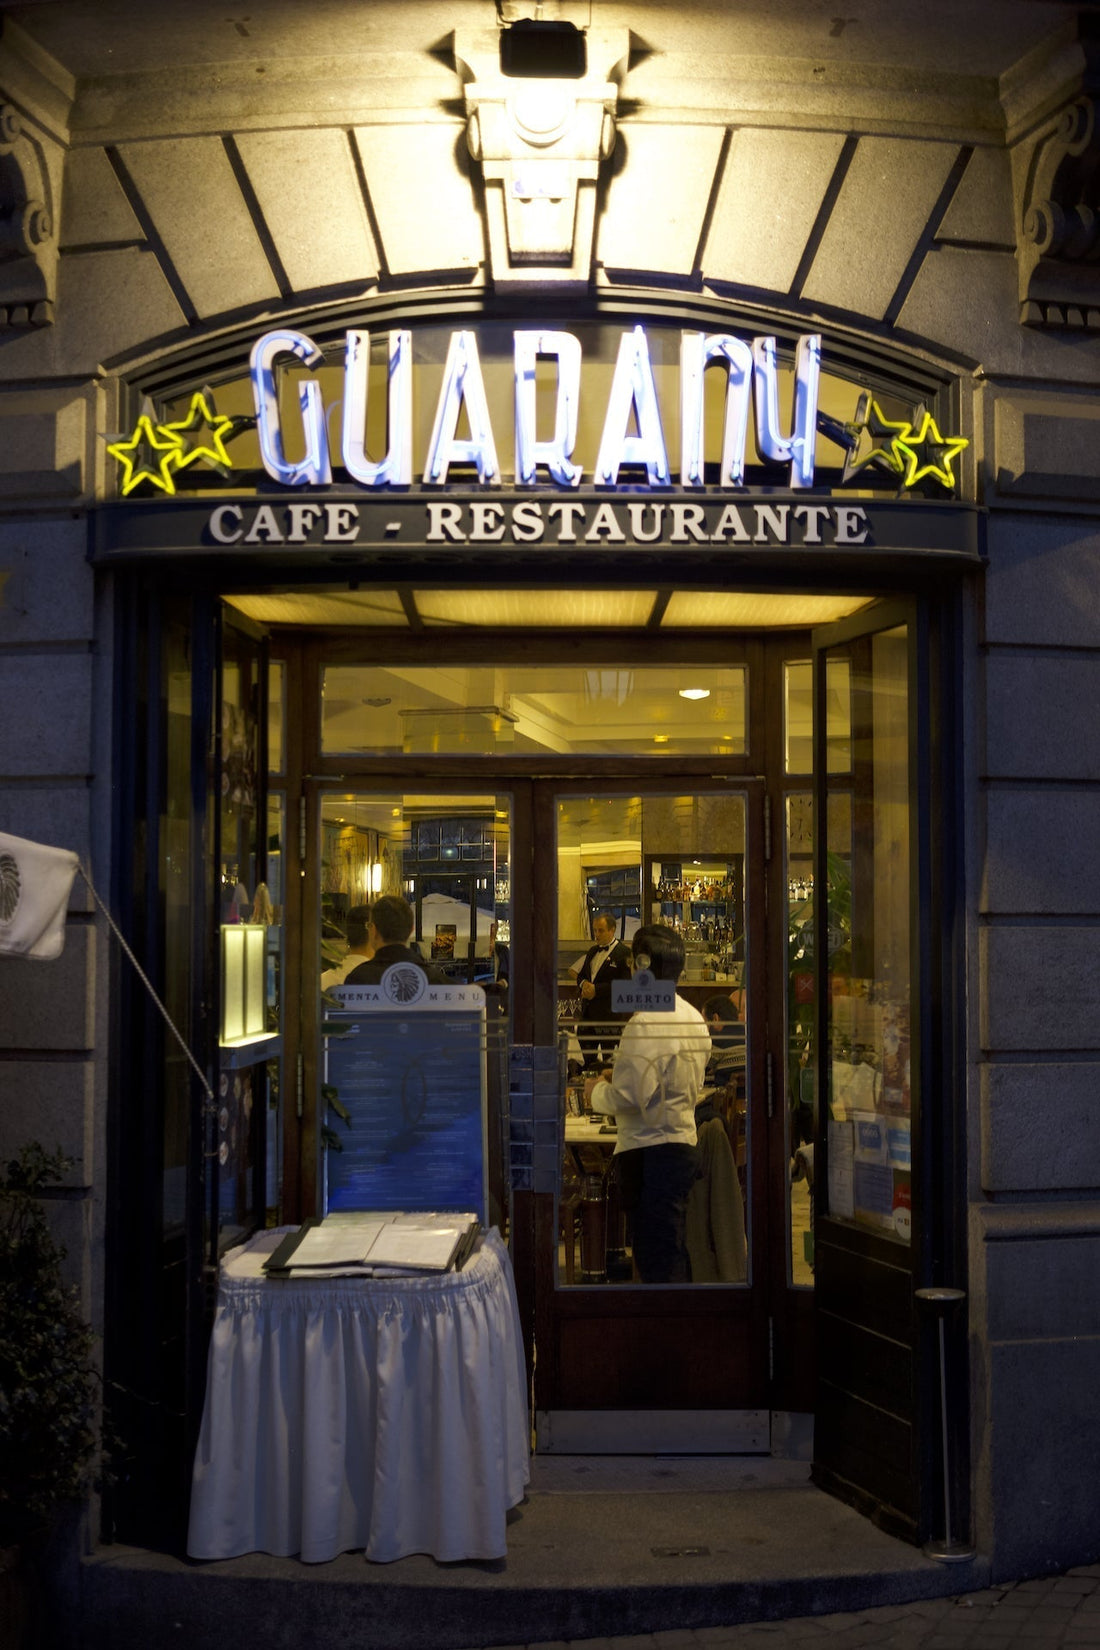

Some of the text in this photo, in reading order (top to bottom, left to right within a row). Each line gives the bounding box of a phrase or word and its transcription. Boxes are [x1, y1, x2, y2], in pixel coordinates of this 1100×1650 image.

[208, 503, 360, 543] CAFE
[426, 502, 869, 544] RESTAURANTE
[429, 992, 480, 1001] MENU
[616, 993, 672, 1004] ABERTO
